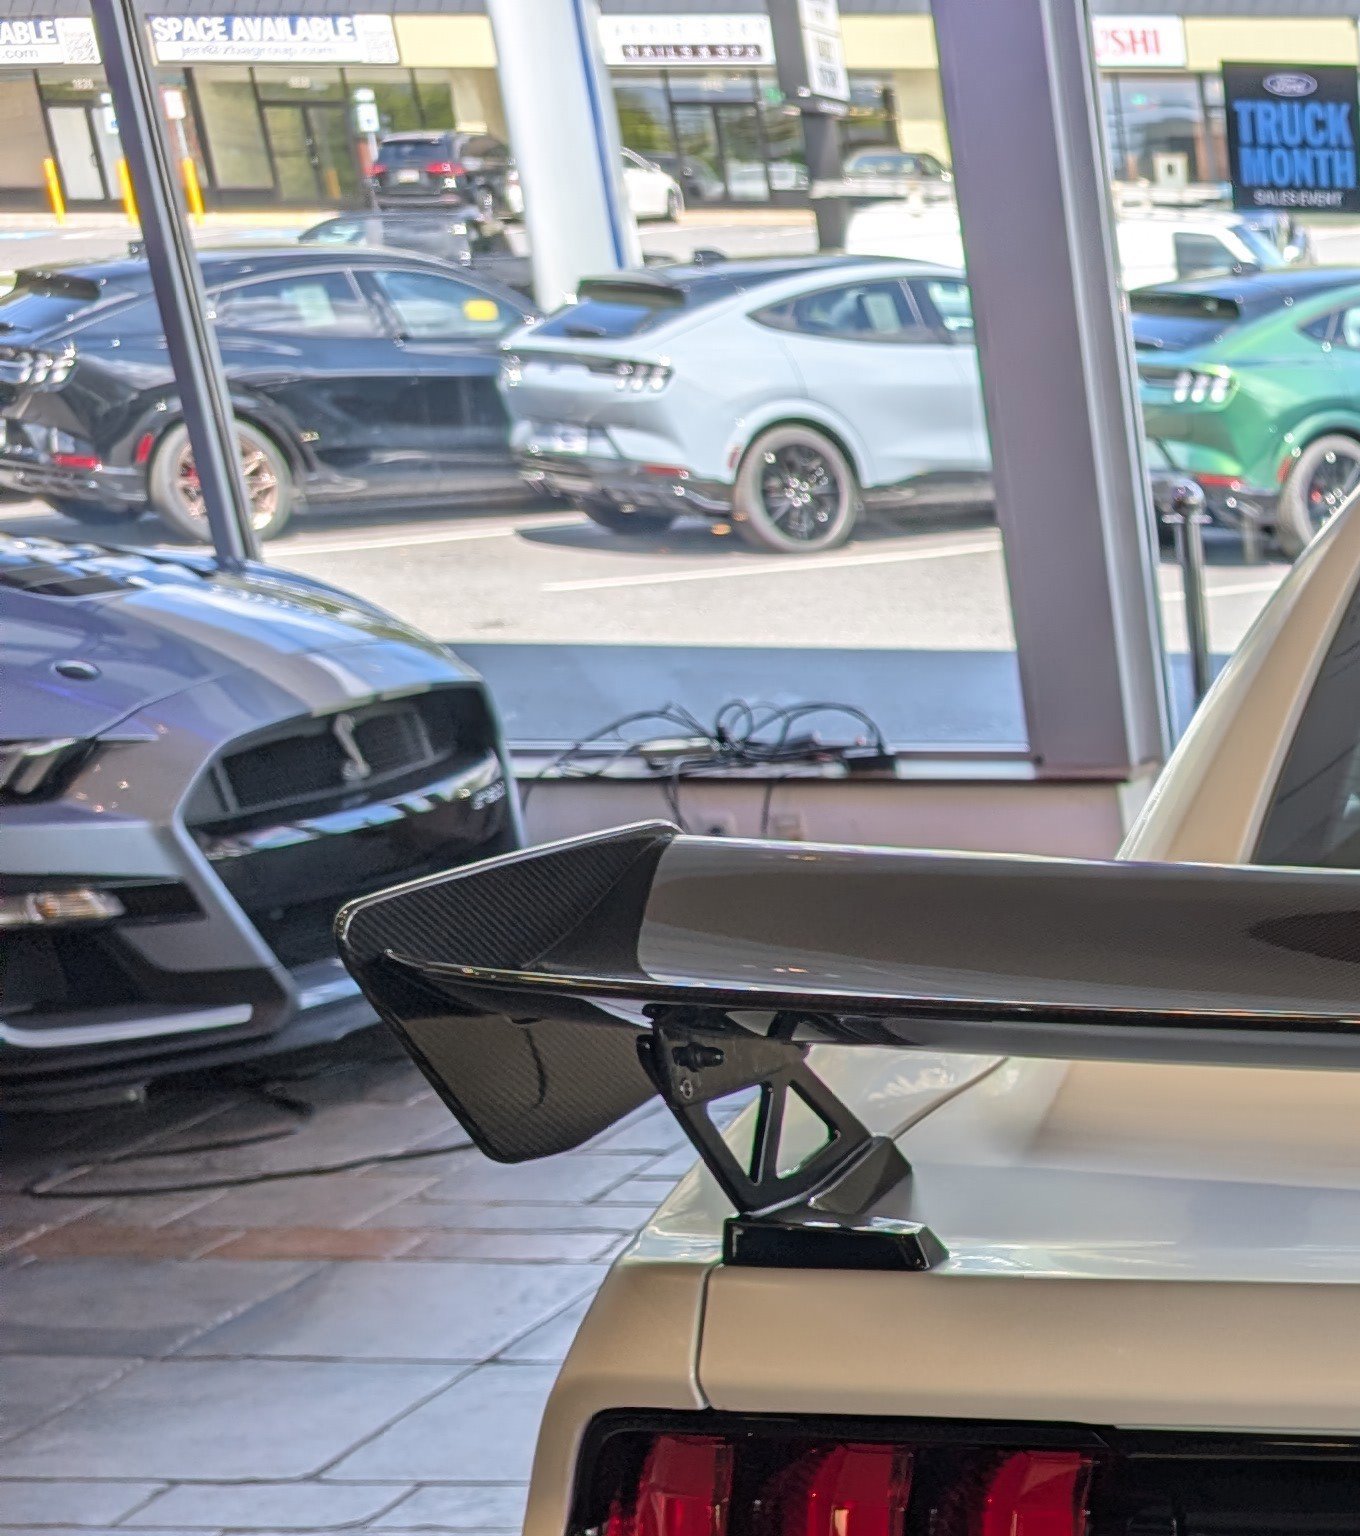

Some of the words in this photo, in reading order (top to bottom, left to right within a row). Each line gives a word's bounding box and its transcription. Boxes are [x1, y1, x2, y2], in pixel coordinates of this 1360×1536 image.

[151, 16, 226, 43] SPACE
[231, 15, 356, 42] AVAILABLE
[1233, 101, 1354, 147] TRUCK
[1239, 147, 1356, 189] MONTH
